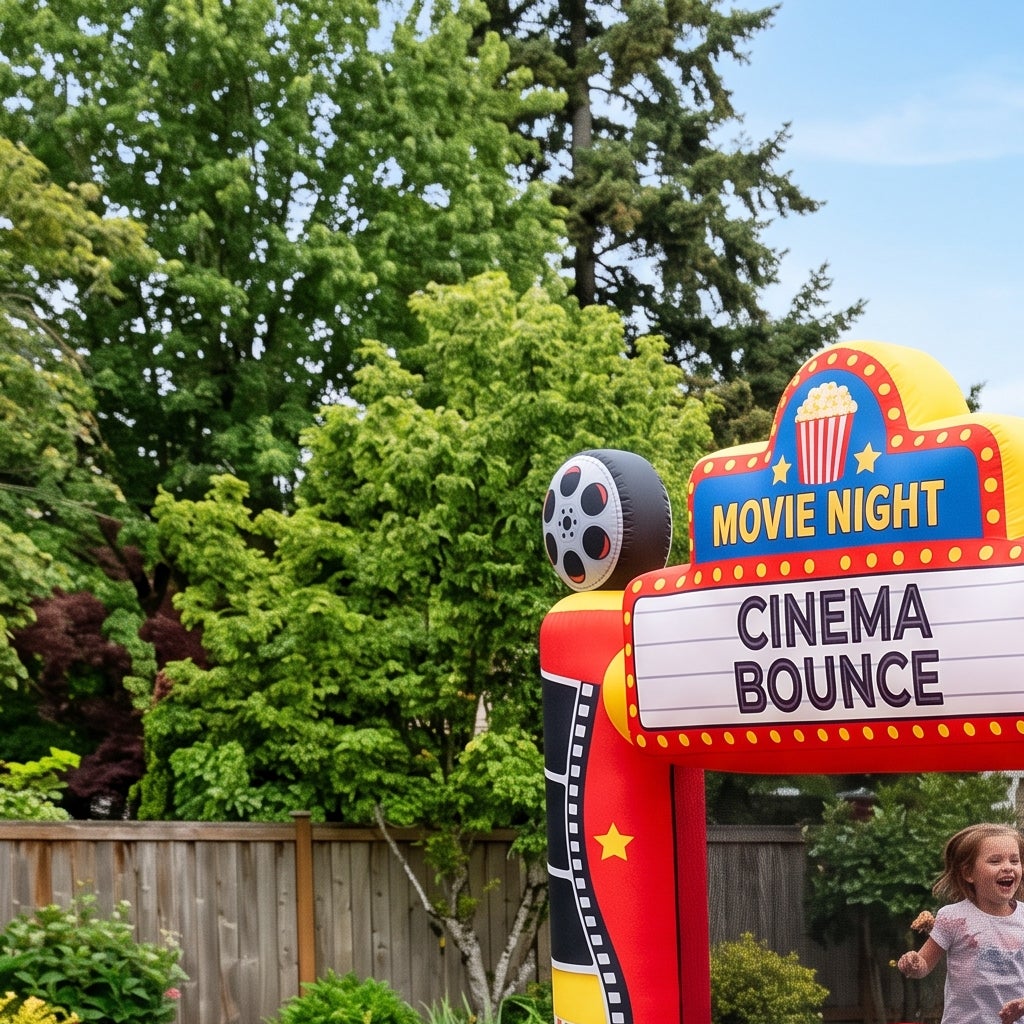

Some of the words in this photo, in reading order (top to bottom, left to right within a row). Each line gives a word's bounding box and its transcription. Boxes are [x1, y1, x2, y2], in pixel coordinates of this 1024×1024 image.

[711, 493, 817, 548] MOVIE
[826, 479, 946, 535] NIGHT
[737, 583, 933, 651] CINEMA
[733, 649, 944, 714] BOUNCE
